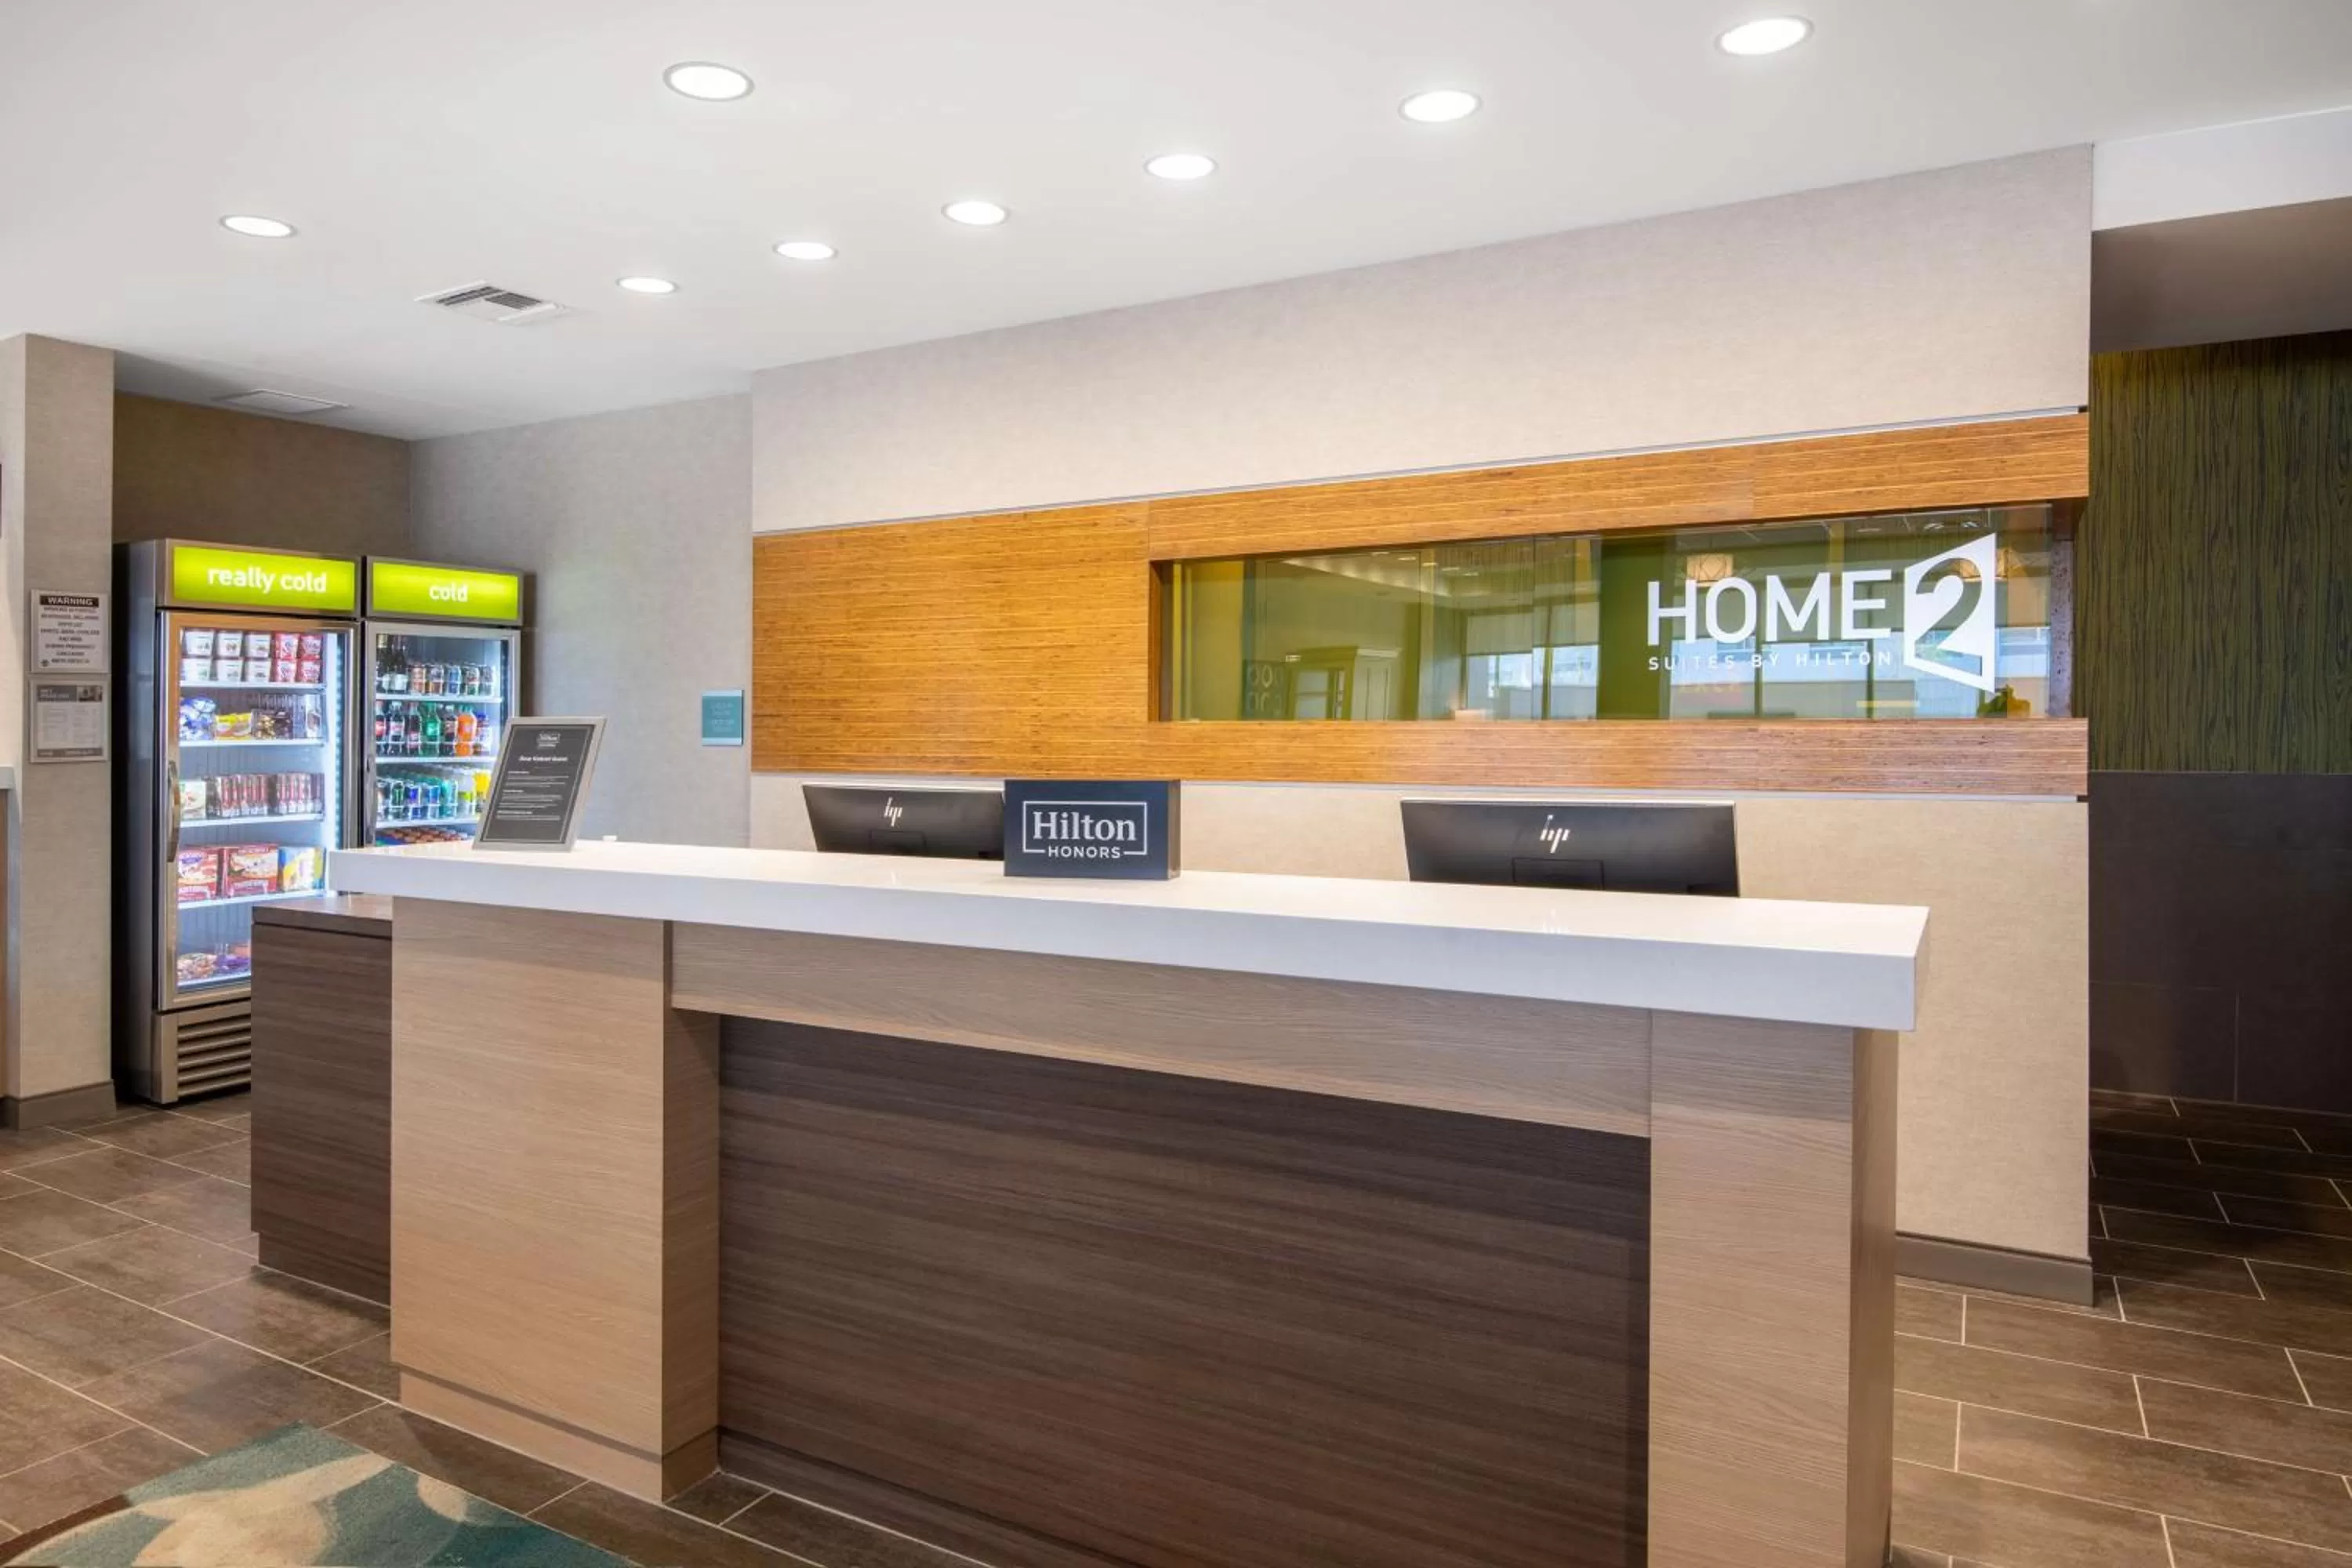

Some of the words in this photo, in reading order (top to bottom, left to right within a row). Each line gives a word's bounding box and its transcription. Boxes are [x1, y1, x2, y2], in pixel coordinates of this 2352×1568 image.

[207, 566, 275, 594] really
[280, 571, 327, 593] cold
[47, 597, 93, 606] WARNING
[429, 583, 468, 602] cold
[1648, 655, 1734, 670] SUITES
[1751, 652, 1780, 668] BY
[1795, 651, 1891, 666] HILTON
[1033, 811, 1138, 841] Hilton
[1540, 814, 1571, 854] hp
[1047, 845, 1121, 859] HONORS
